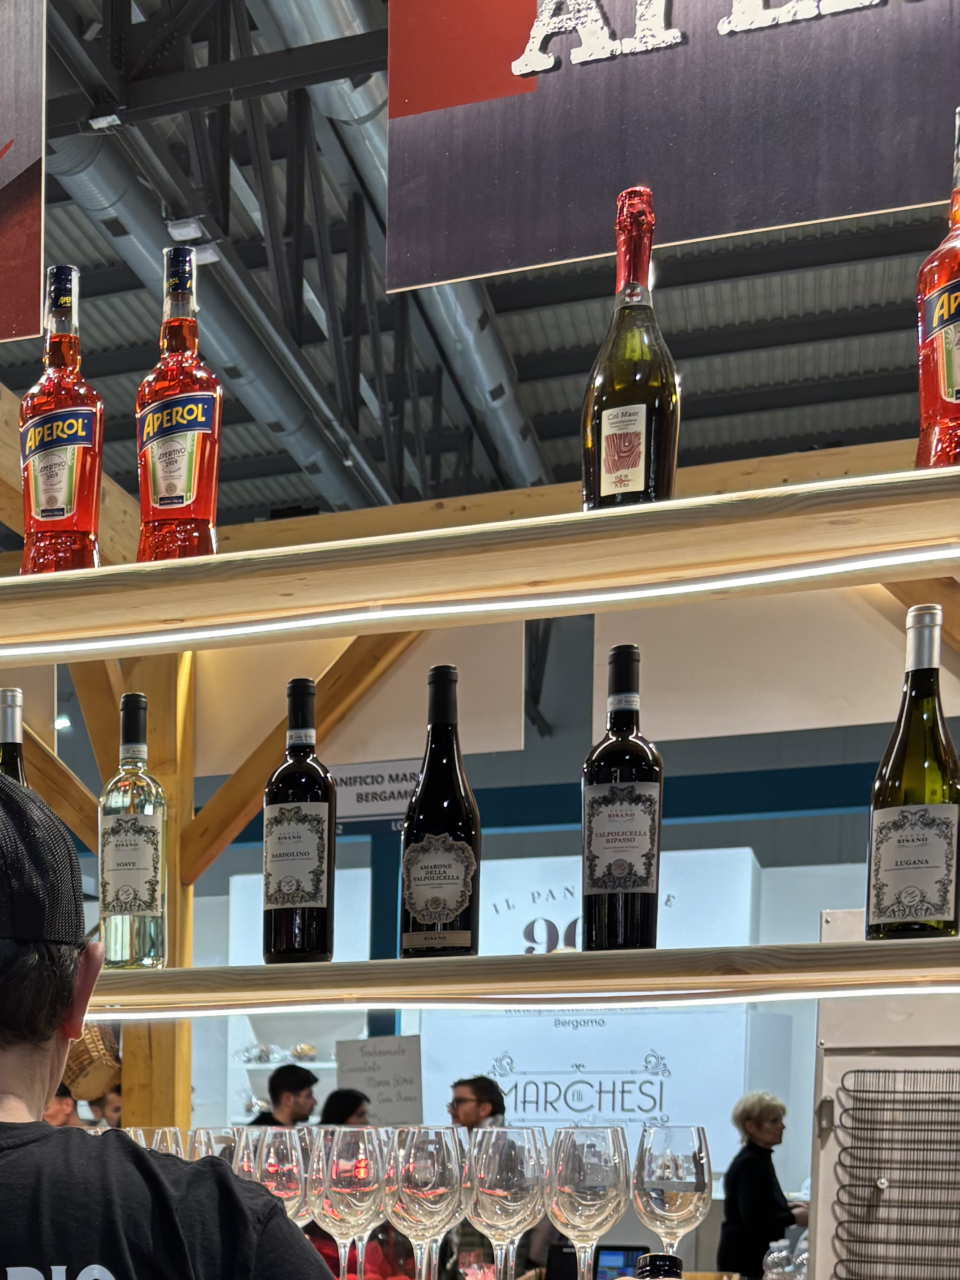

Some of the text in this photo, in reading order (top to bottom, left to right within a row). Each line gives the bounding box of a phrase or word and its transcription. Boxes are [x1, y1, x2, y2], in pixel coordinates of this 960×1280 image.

[25, 418, 86, 456] APEROL
[142, 403, 206, 443] APEROL
[895, 859, 929, 867] LUGANA
[553, 1017, 607, 1031] Bergamo
[498, 1079, 663, 1114] MARCHESI
